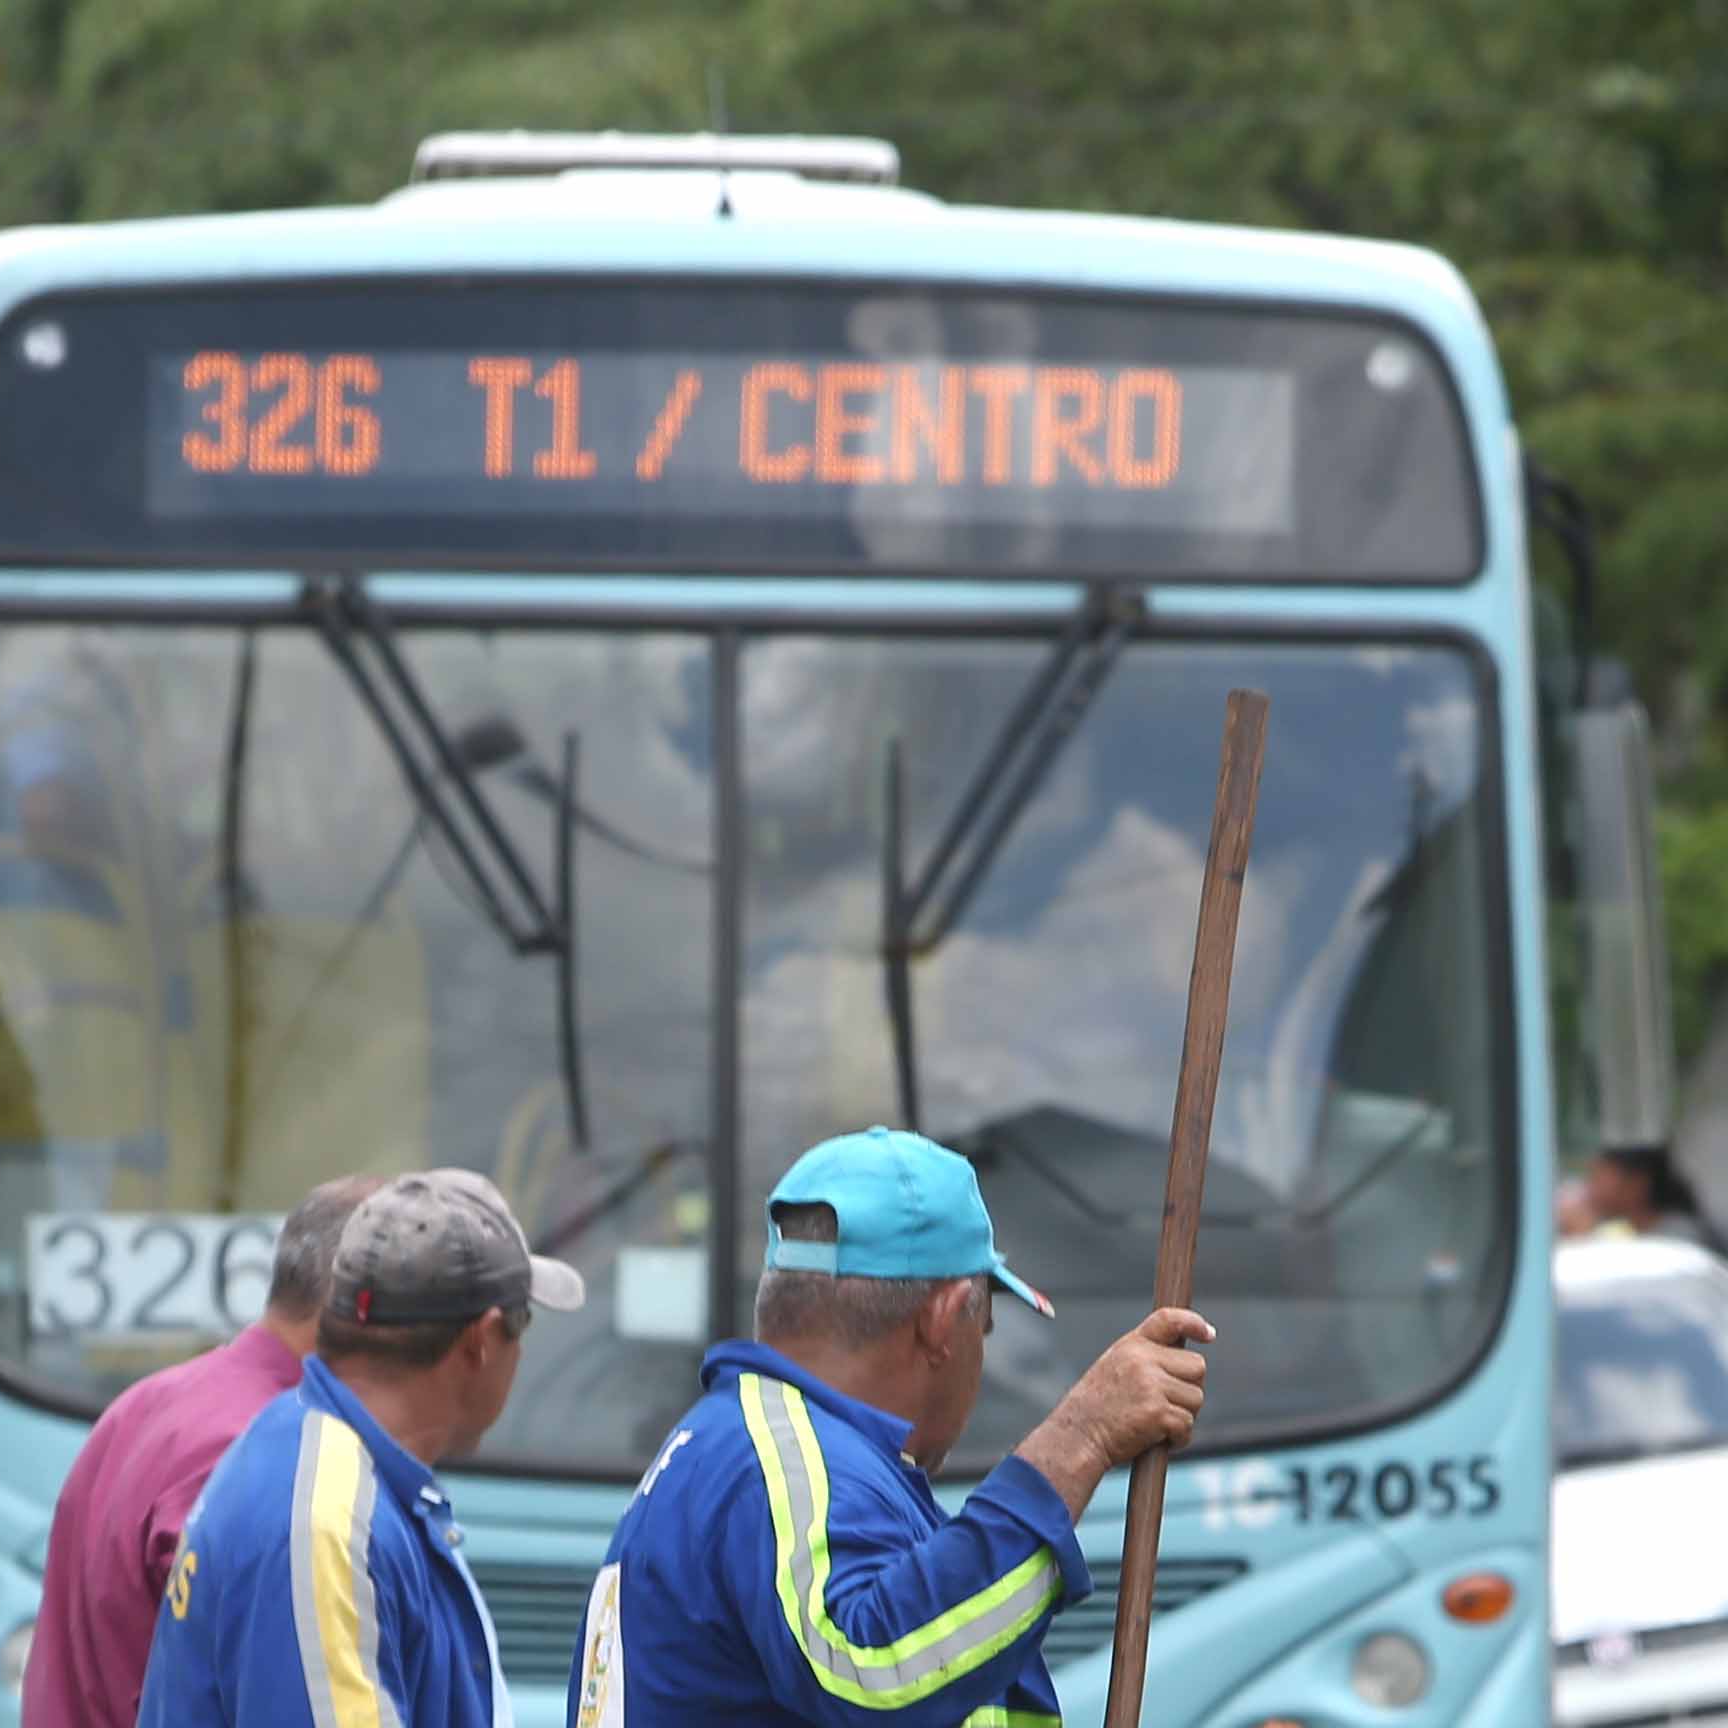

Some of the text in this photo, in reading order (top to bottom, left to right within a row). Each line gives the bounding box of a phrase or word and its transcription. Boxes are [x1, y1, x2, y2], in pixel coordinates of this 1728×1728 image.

[181, 350, 1183, 488] 326 T1 / CENTRO
[37, 1220, 274, 1332] 326
